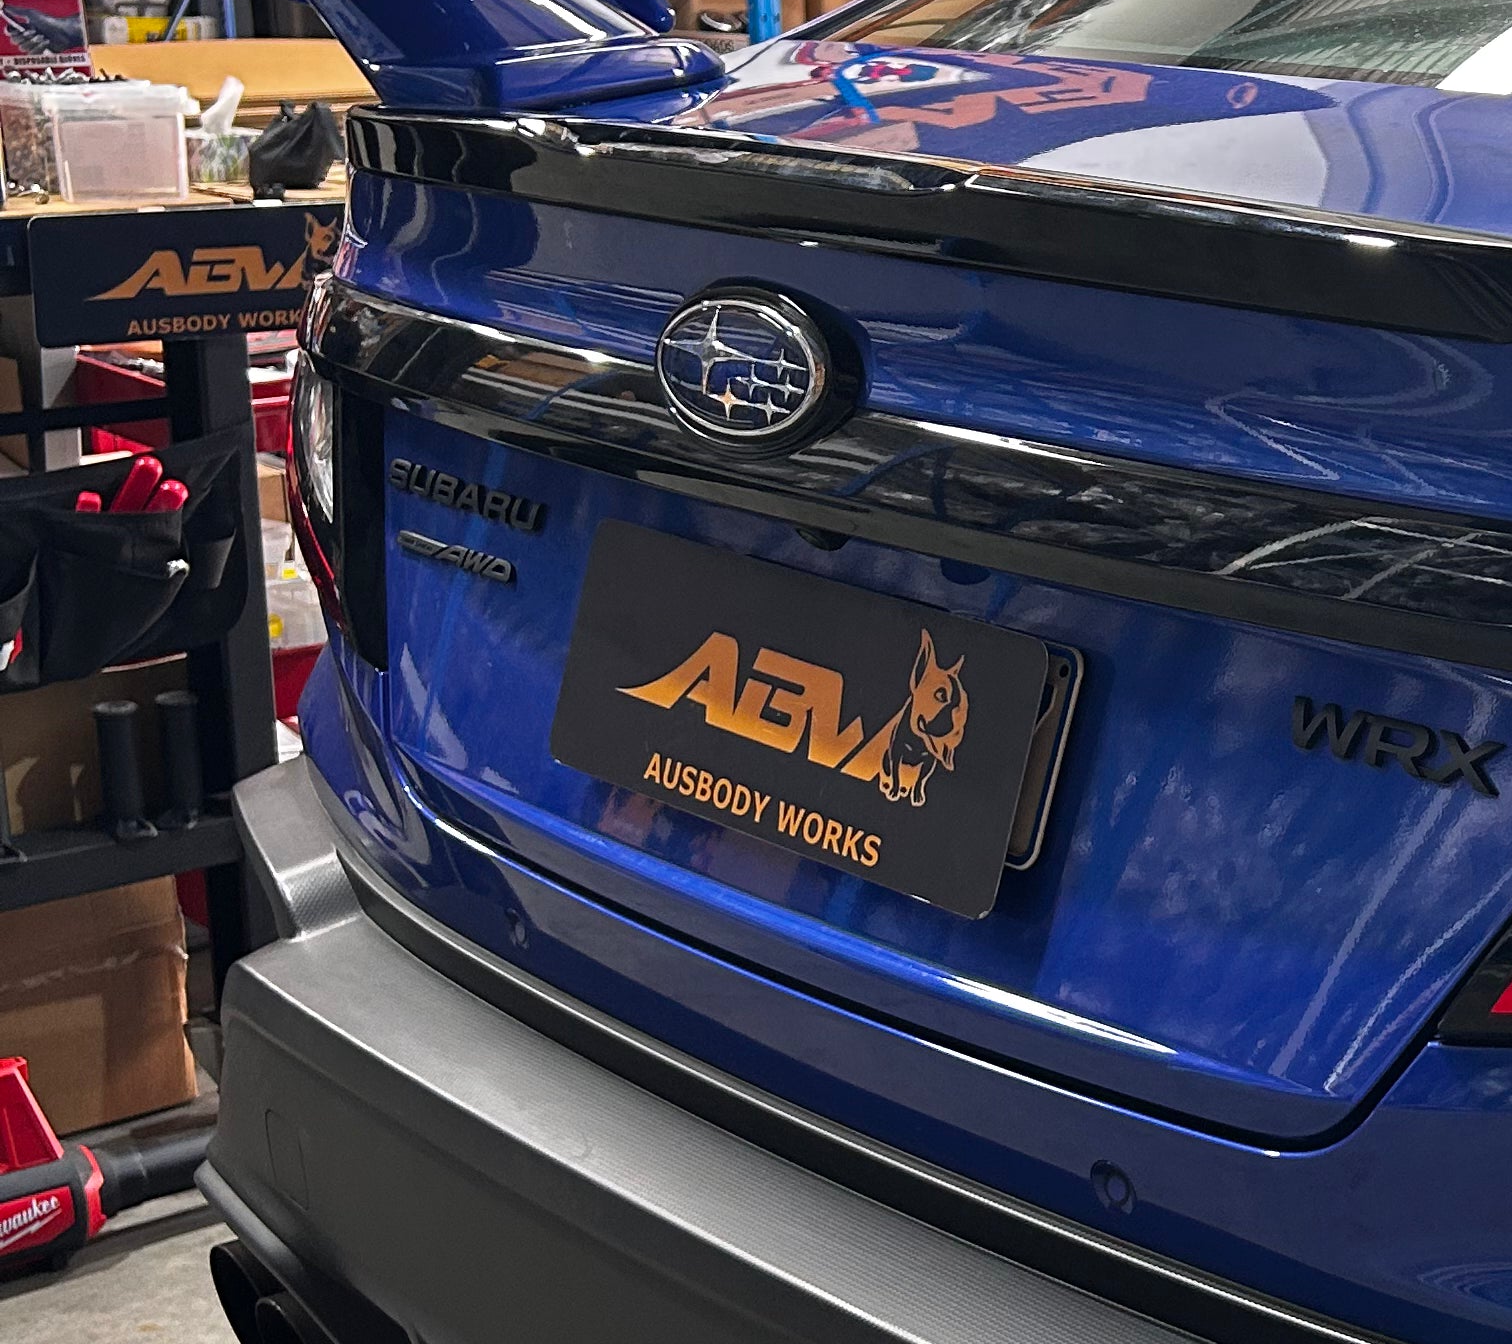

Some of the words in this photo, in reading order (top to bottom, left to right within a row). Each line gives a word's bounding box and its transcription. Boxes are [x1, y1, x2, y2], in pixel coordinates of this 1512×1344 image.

[84, 245, 310, 303] ABW
[128, 313, 231, 336] AUSBODY
[239, 307, 302, 330] WORK
[388, 457, 544, 532] SUBARU
[437, 543, 516, 584] AWD
[615, 631, 909, 783] ABW
[1291, 694, 1507, 799] WRX
[643, 752, 772, 824] AUSBODY
[776, 799, 883, 868] WORKS
